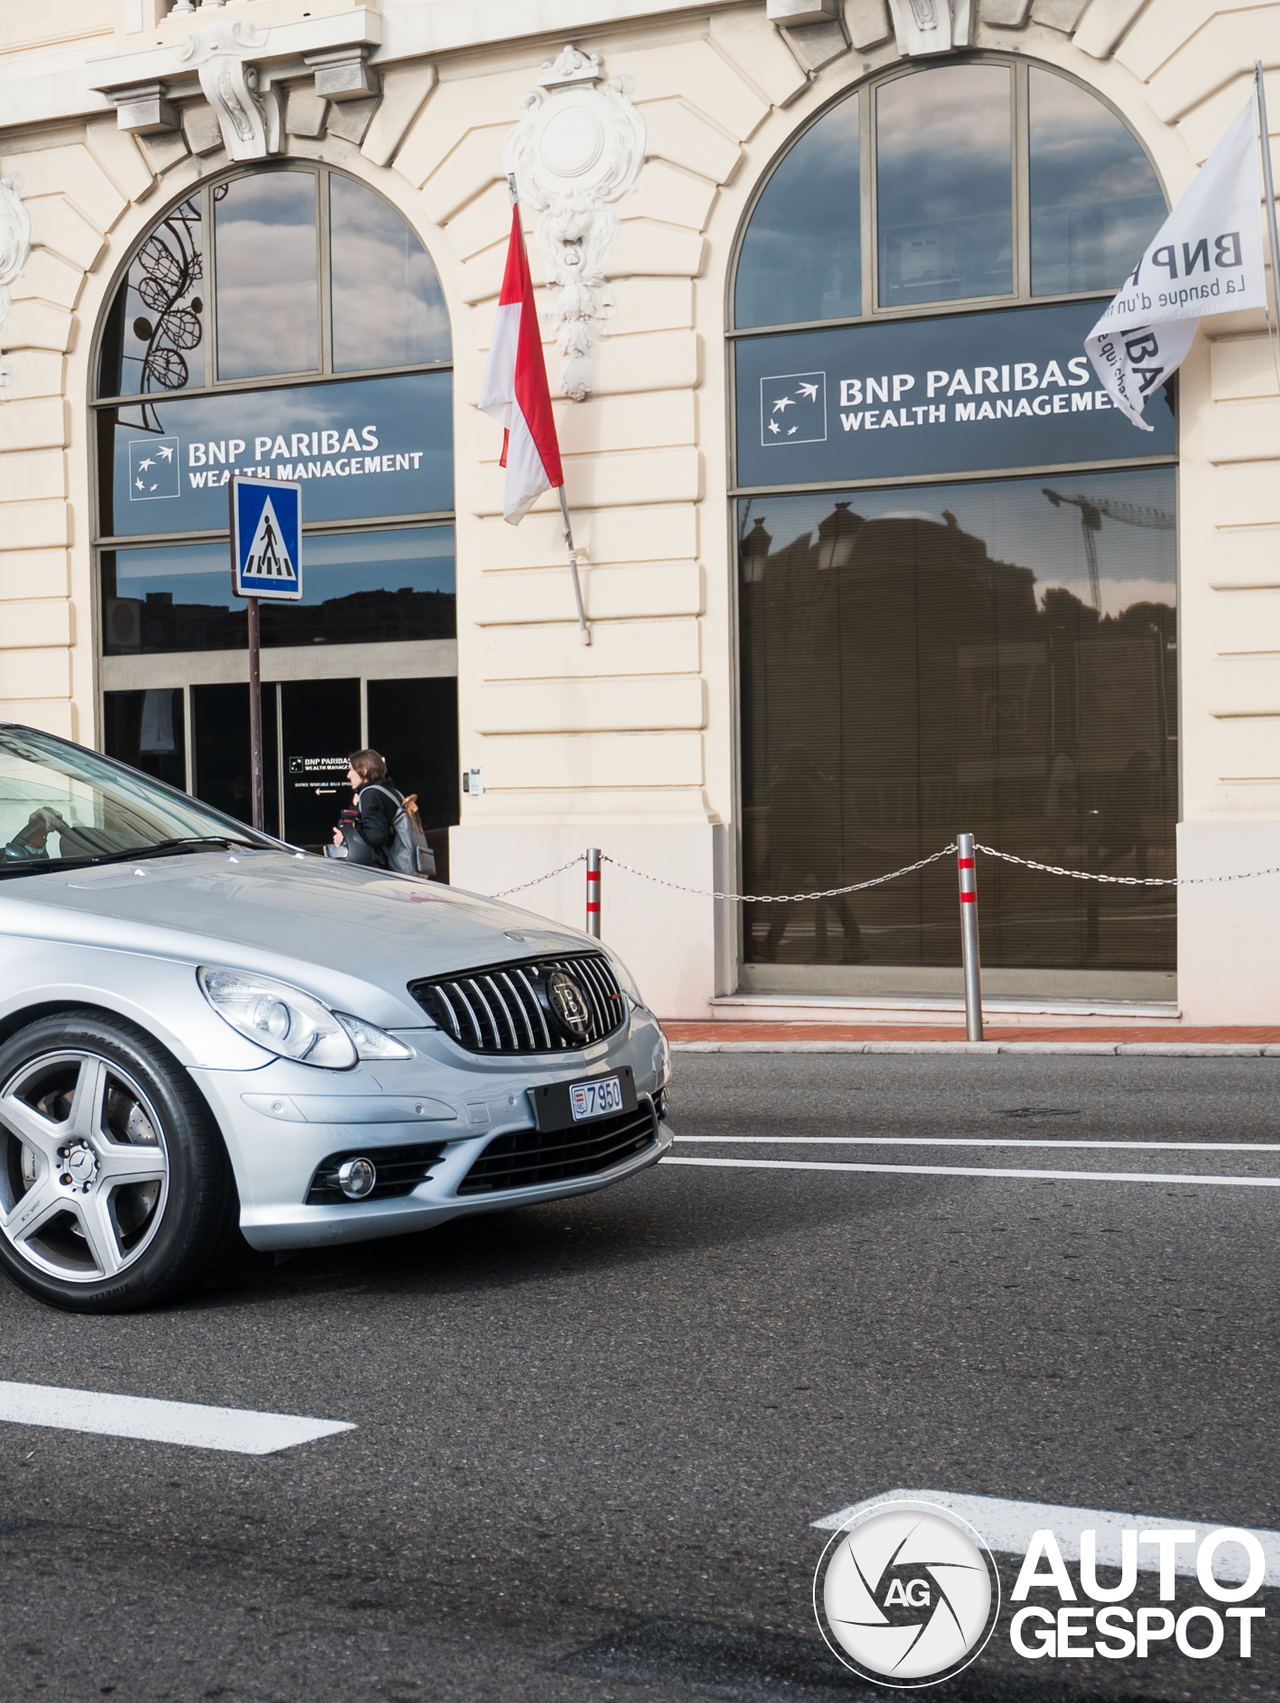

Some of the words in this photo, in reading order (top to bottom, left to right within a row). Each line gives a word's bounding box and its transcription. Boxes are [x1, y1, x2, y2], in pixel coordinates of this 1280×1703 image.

[1099, 342, 1122, 367] qui
[1120, 325, 1164, 405] BA
[839, 374, 915, 407] BNP
[926, 356, 1091, 398] PARIBAS
[839, 404, 946, 432] WEALTH
[955, 390, 1121, 422] MANAGEME
[189, 439, 246, 467] BNP
[255, 425, 379, 461] PARIBAS
[277, 452, 424, 480] MANAGEMENT
[587, 1081, 621, 1113] 7950
